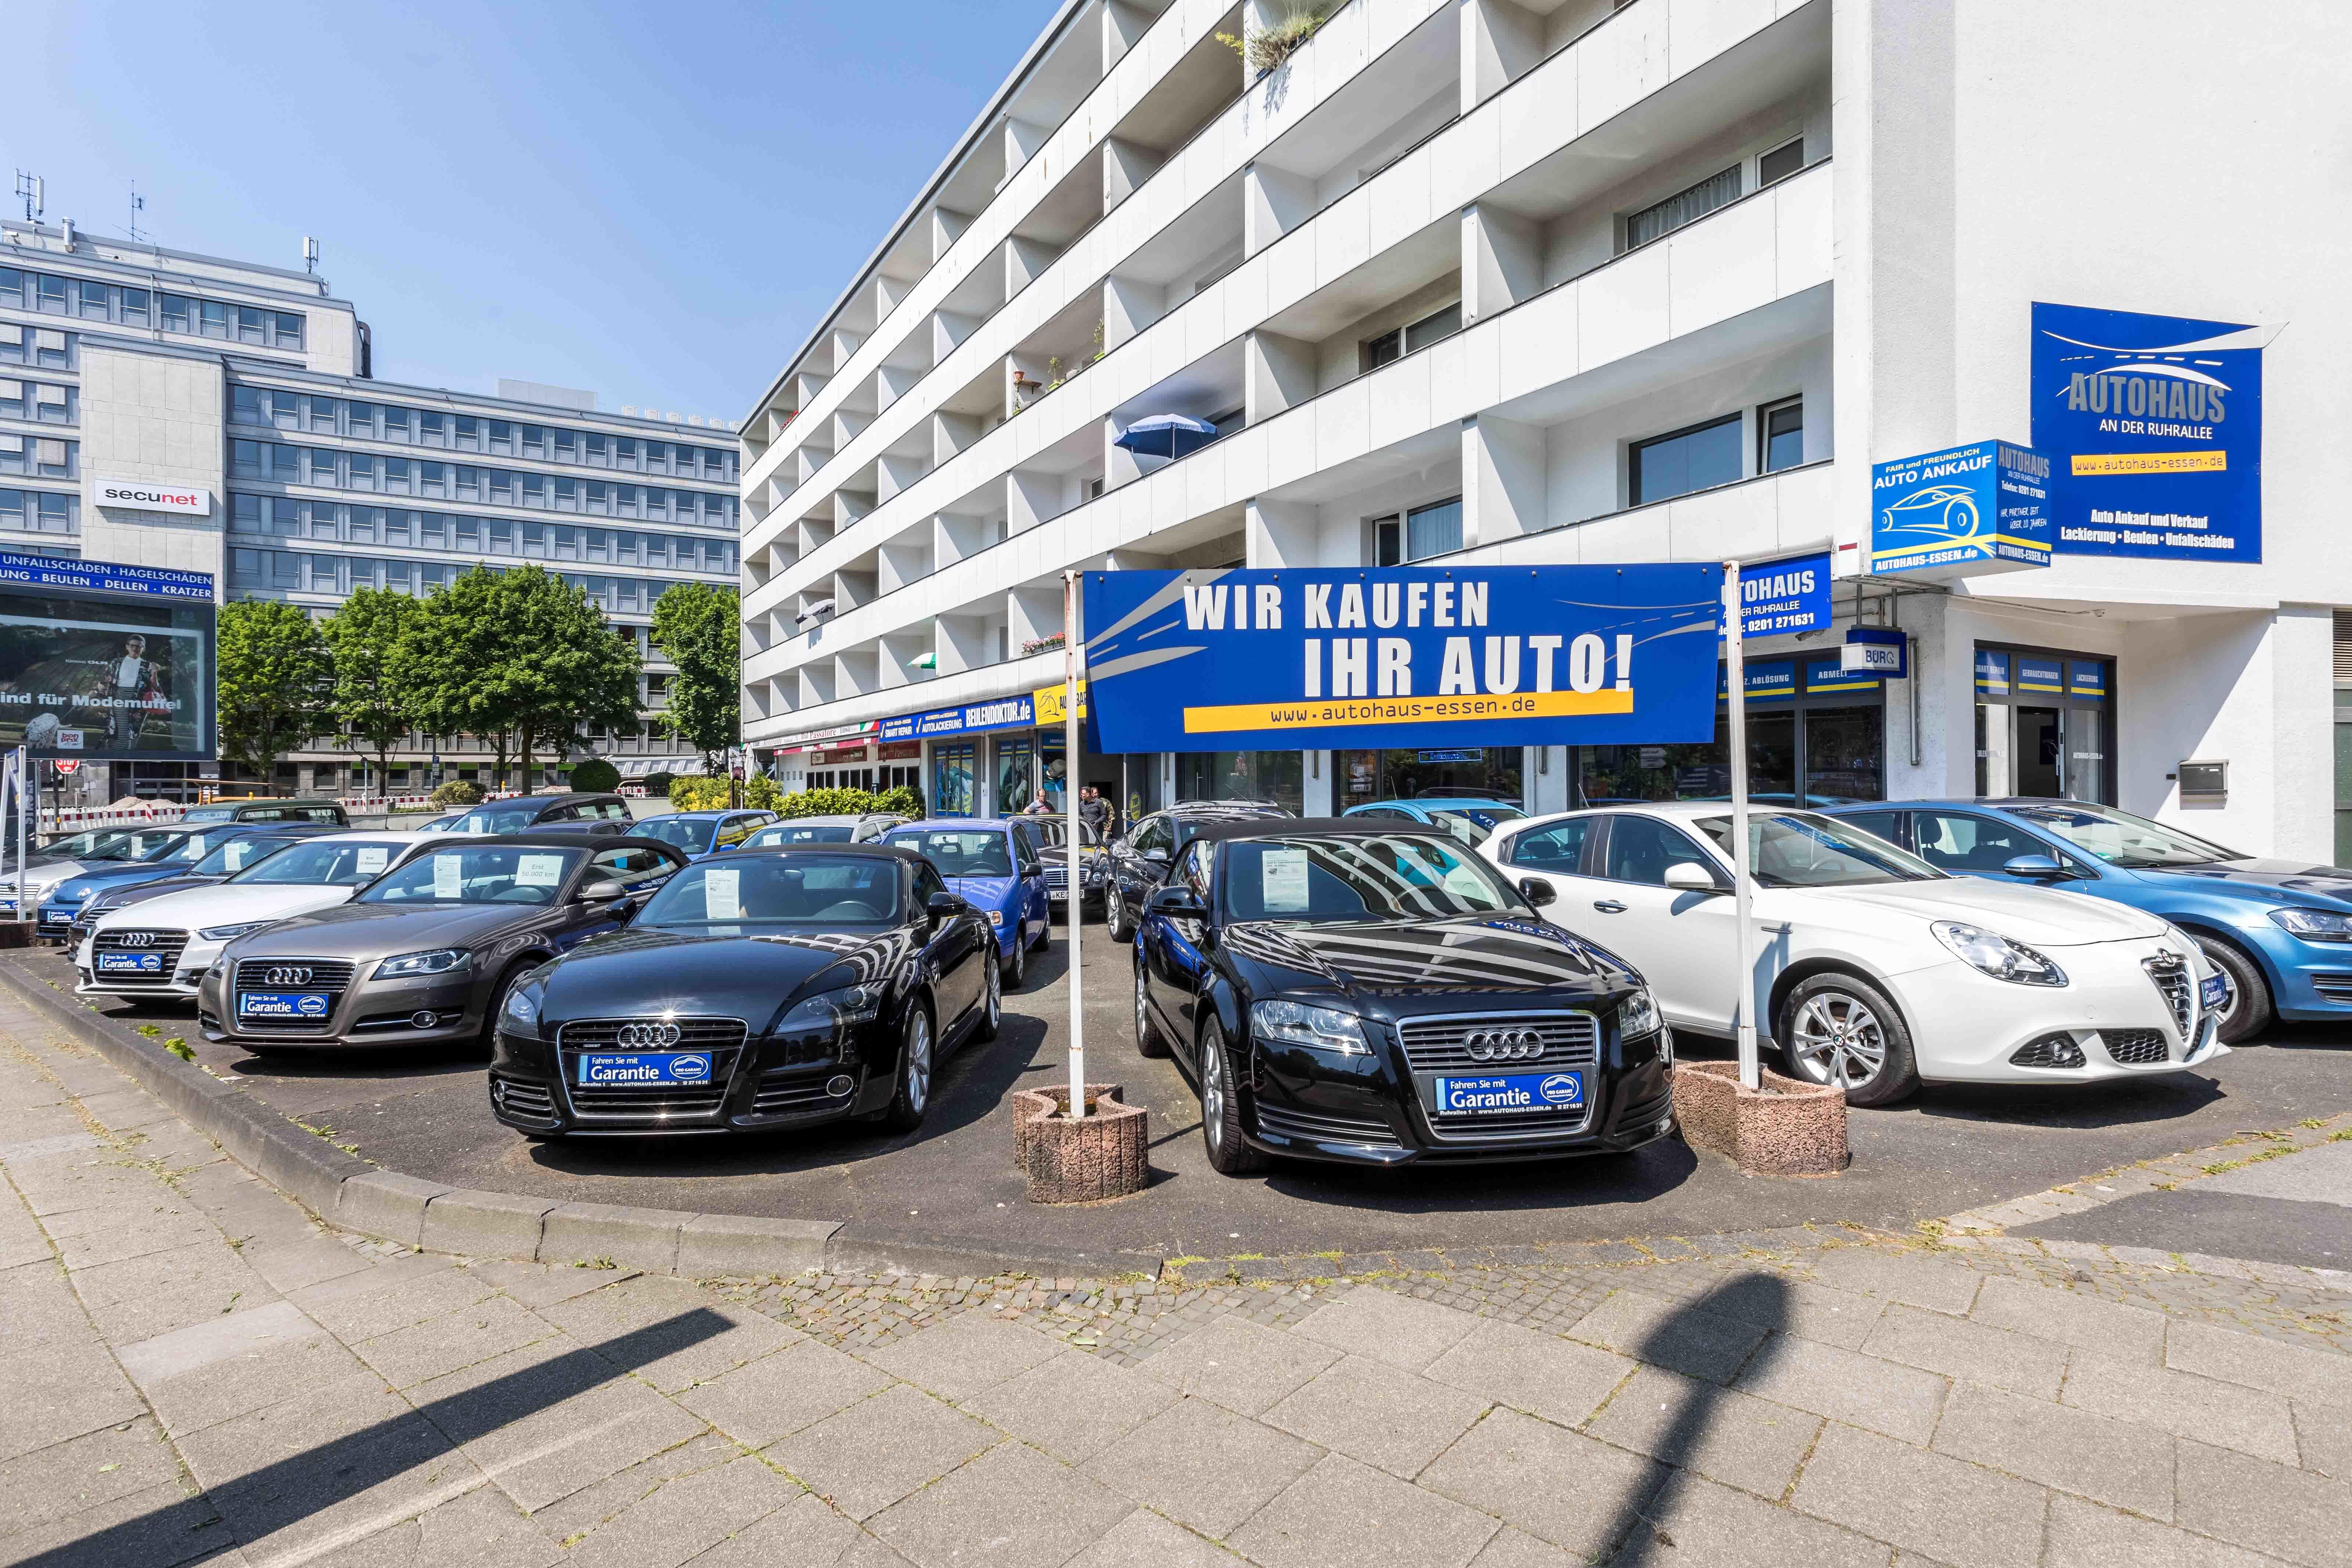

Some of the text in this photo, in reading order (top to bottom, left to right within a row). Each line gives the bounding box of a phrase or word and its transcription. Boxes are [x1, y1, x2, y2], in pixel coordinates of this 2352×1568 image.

[2068, 373, 2225, 423] AUTOHAUS
[2099, 419, 2213, 439] AN DER RUHRALLEE
[1886, 448, 1979, 473] FAIR und FREUNDLICH
[1998, 445, 2050, 478] AUTOHAUS
[2075, 456, 2223, 471] www.autohaus-essen.de
[1874, 455, 1992, 489] AUTO ANKAUF
[2021, 473, 2040, 484] RUHRALLEE
[105, 489, 197, 506] secunet
[2002, 480, 2046, 499] Telefon: 0201 271631
[2009, 507, 2029, 517] PARTNER
[2030, 506, 2039, 516] SEIT
[2091, 509, 2208, 528] Auto Ankauf und Verkauf
[2010, 519, 2022, 529] ÜBER
[2030, 518, 2047, 530] JAHREN
[2061, 527, 2234, 548] Lackierung Beulen Unfallschäden
[1875, 548, 1977, 571] AUTOHAUS-ESSEN.de
[1999, 545, 2048, 563] AUTOHAUS-ESSEN.de
[3, 555, 212, 585] UNFALLSCHÄDEN HAGELSCHÄDEN
[42, 574, 89, 586] BEULEN
[105, 580, 147, 591] DELLEN
[162, 585, 212, 598] KRATZER
[1721, 570, 1815, 605] TOHAUS
[1184, 582, 1487, 629] WIR KAUFEN
[1723, 600, 1800, 619] A ER RUHRALLEE
[1748, 618, 1772, 632] 0201
[1776, 613, 1814, 628] 271631
[1305, 634, 1633, 697] IHR AUTO!
[1990, 665, 2005, 674] REPAIR
[2022, 669, 2058, 679] GEBRAUCHTWAGEN
[1752, 674, 1789, 685] ABLÖSUNG
[2076, 674, 2098, 683] LACKIERUNG
[38, 693, 67, 706] für
[72, 695, 182, 710] Modemuffel
[1271, 697, 1535, 723] www.autohaus-essen.de
[966, 701, 1030, 727] BEULENDOKTOR.de
[810, 728, 836, 739] Passatore
[885, 726, 912, 738] SMART REPAIR
[922, 719, 962, 733] AUTOLACKIERUNG
[104, 959, 137, 968] Garantie
[247, 1001, 291, 1012] Garantie
[591, 1065, 659, 1080] Garantie
[1450, 1080, 1476, 1089] Fahren
[1479, 1080, 1491, 1088] Sie
[1450, 1088, 1530, 1108] Garantie
[1478, 1105, 1551, 1114] www.AUTOHAUS-ESSEN.de
